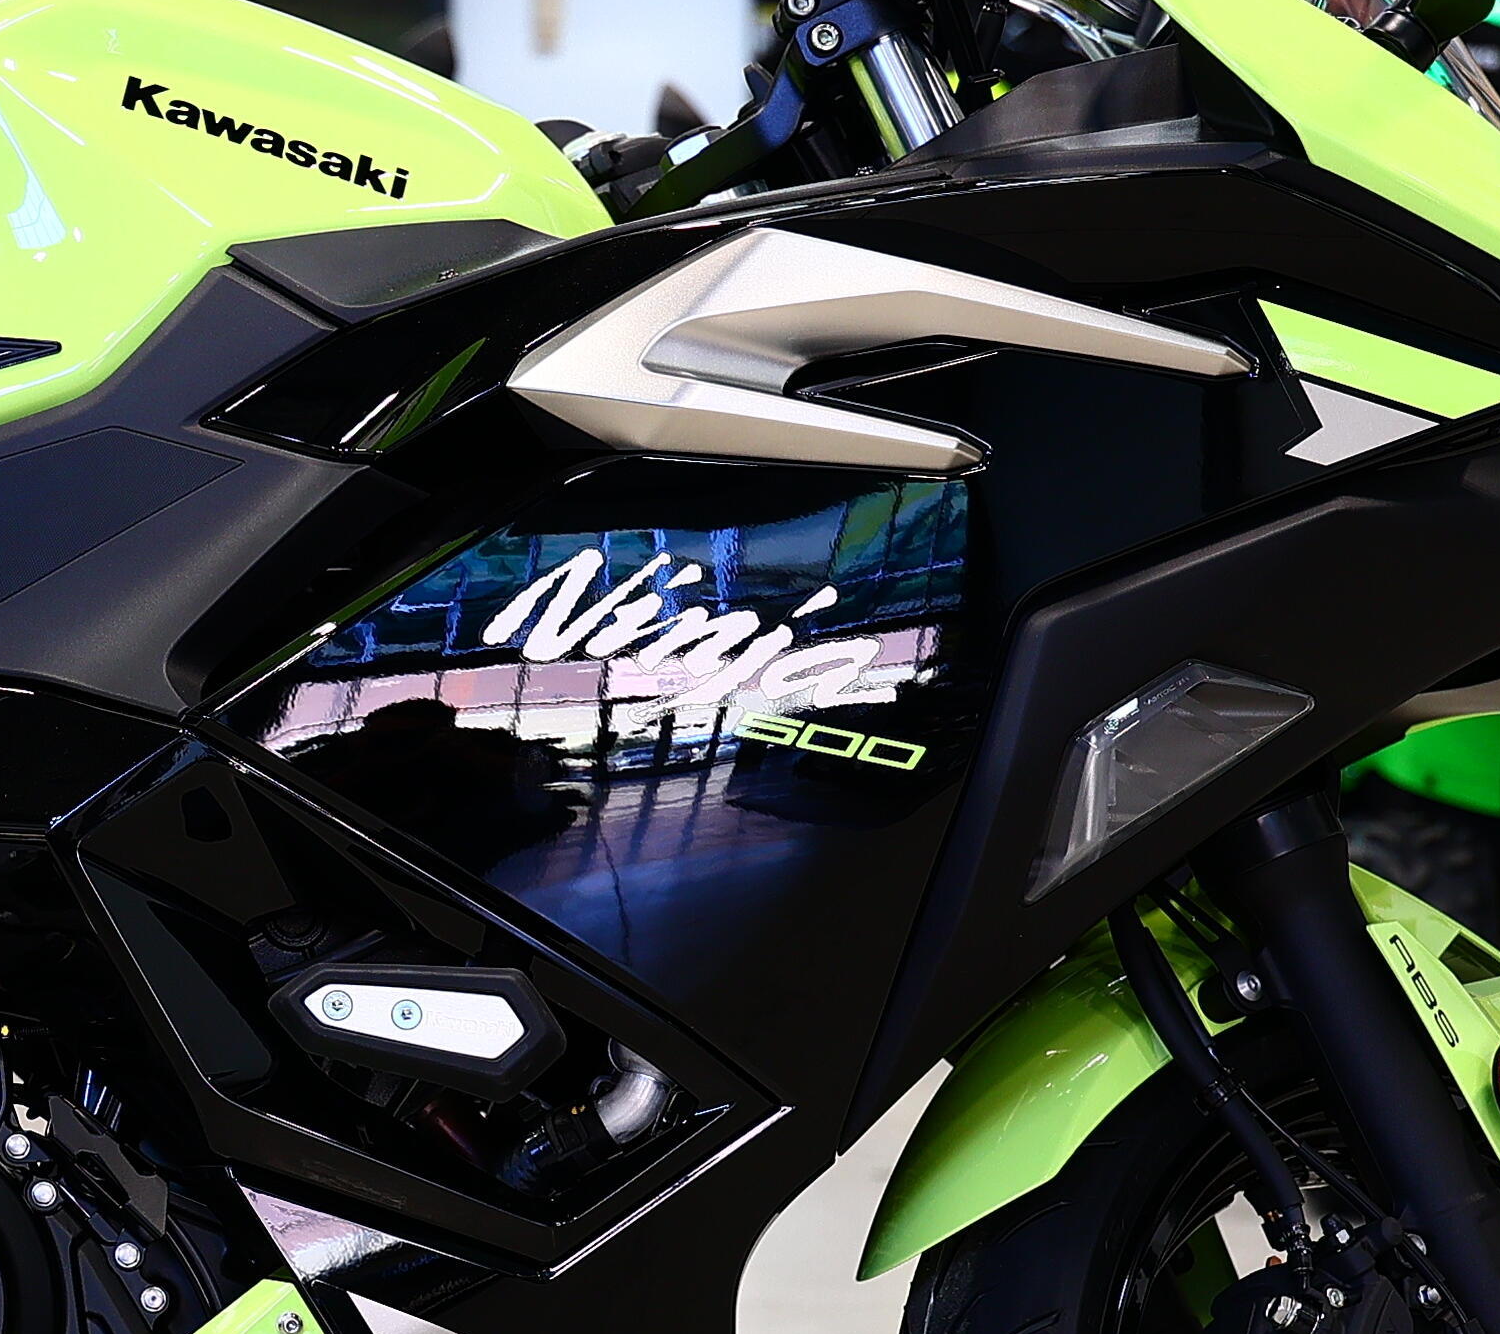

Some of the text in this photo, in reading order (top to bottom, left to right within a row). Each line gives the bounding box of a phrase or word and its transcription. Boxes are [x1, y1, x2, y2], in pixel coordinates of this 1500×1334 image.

[120, 75, 410, 201] Kawasaki
[481, 547, 897, 723] Ninja
[733, 712, 927, 771] 500
[1388, 933, 1460, 1048] ABS
